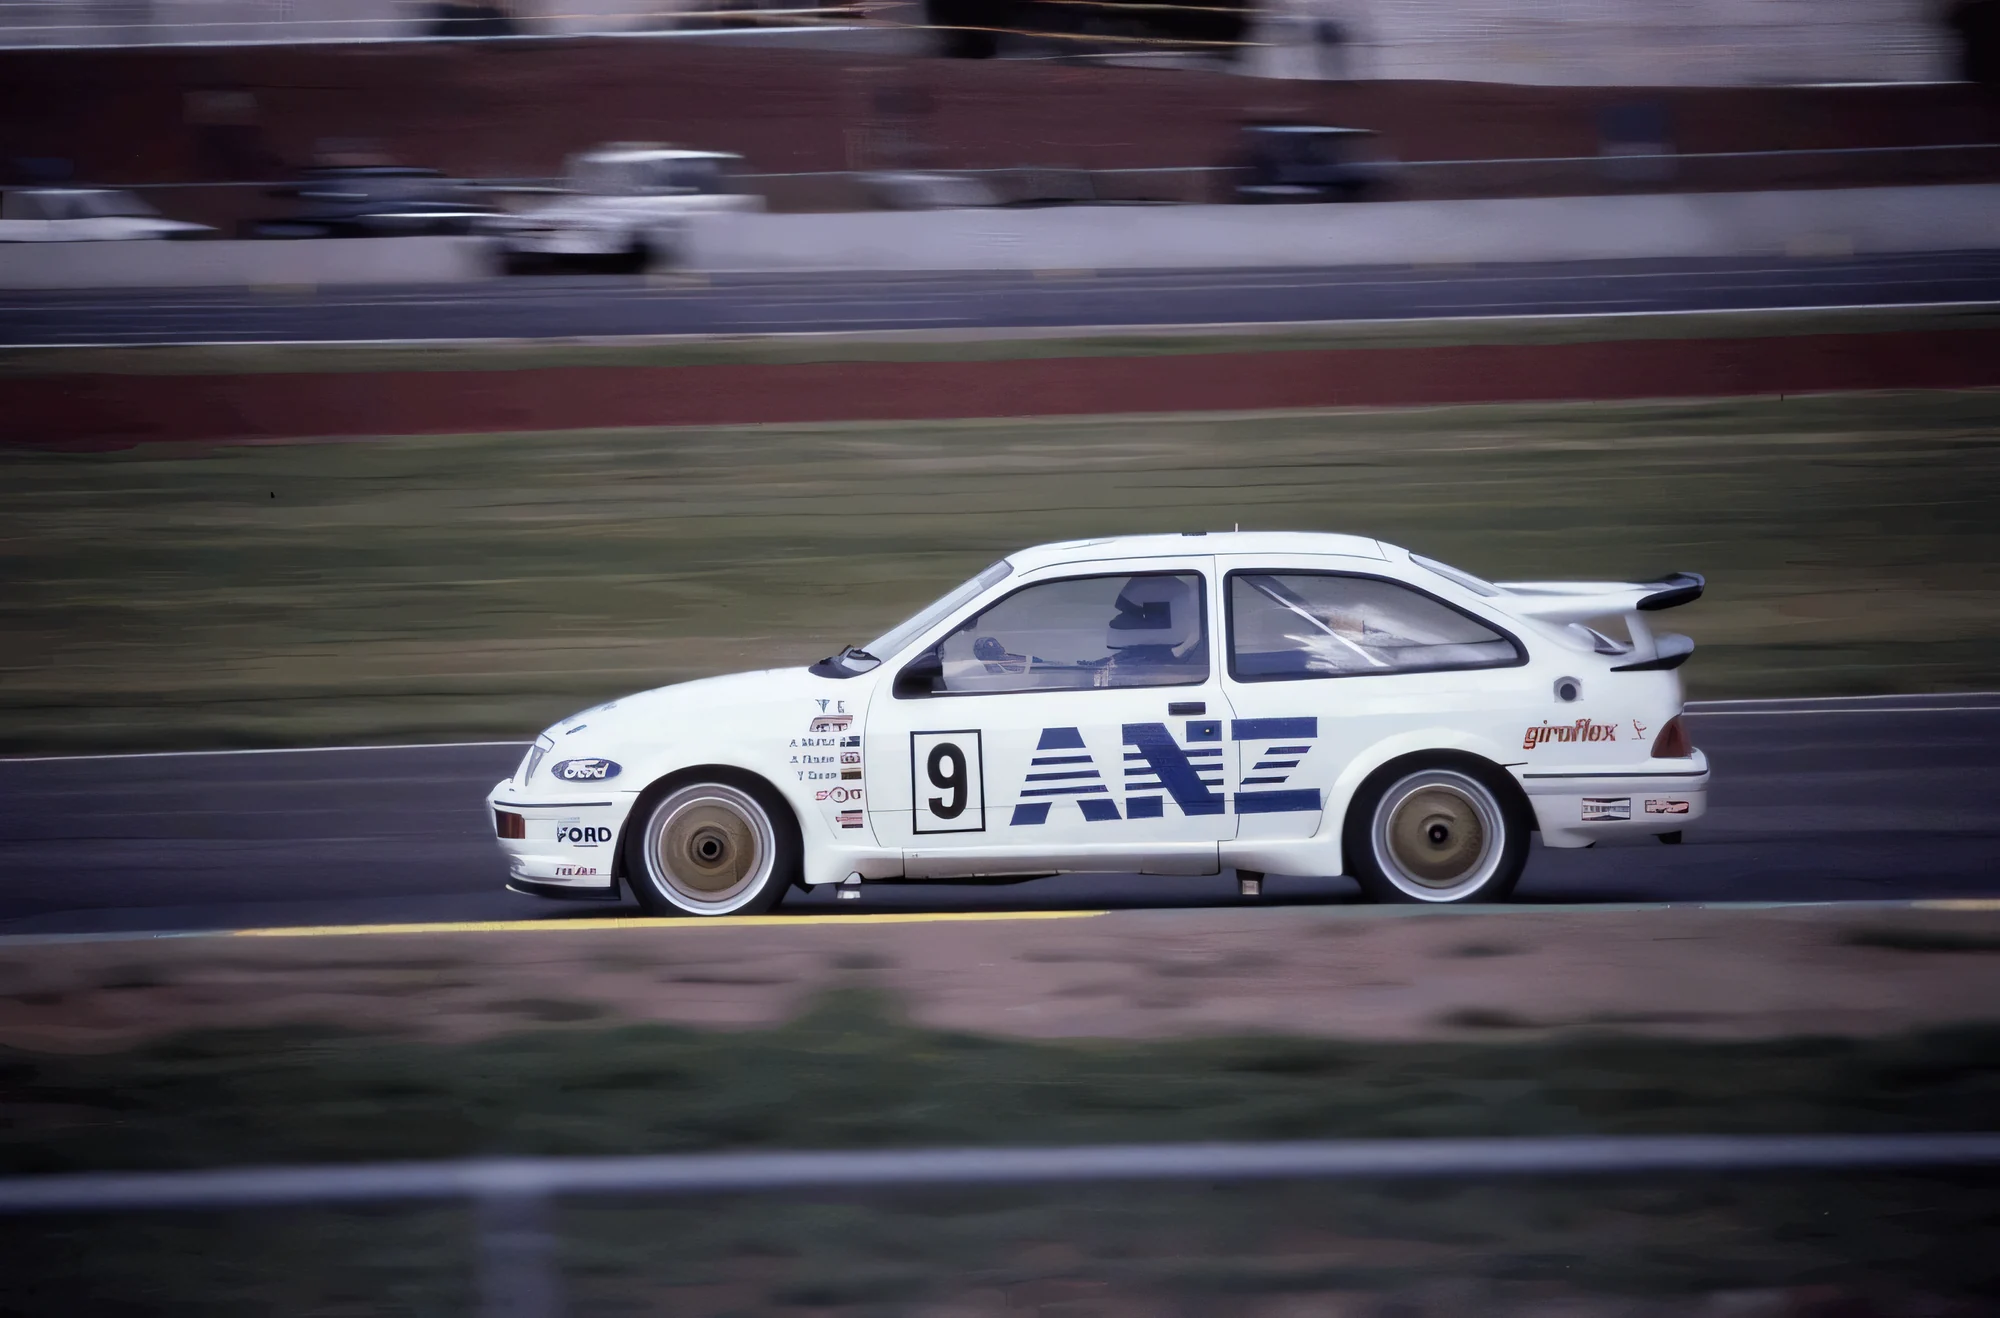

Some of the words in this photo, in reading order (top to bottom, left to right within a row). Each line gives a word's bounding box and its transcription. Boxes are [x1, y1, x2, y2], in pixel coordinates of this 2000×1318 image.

[926, 742, 968, 820] 9
[1009, 716, 1323, 826] ANZ
[557, 826, 612, 843] FORD
